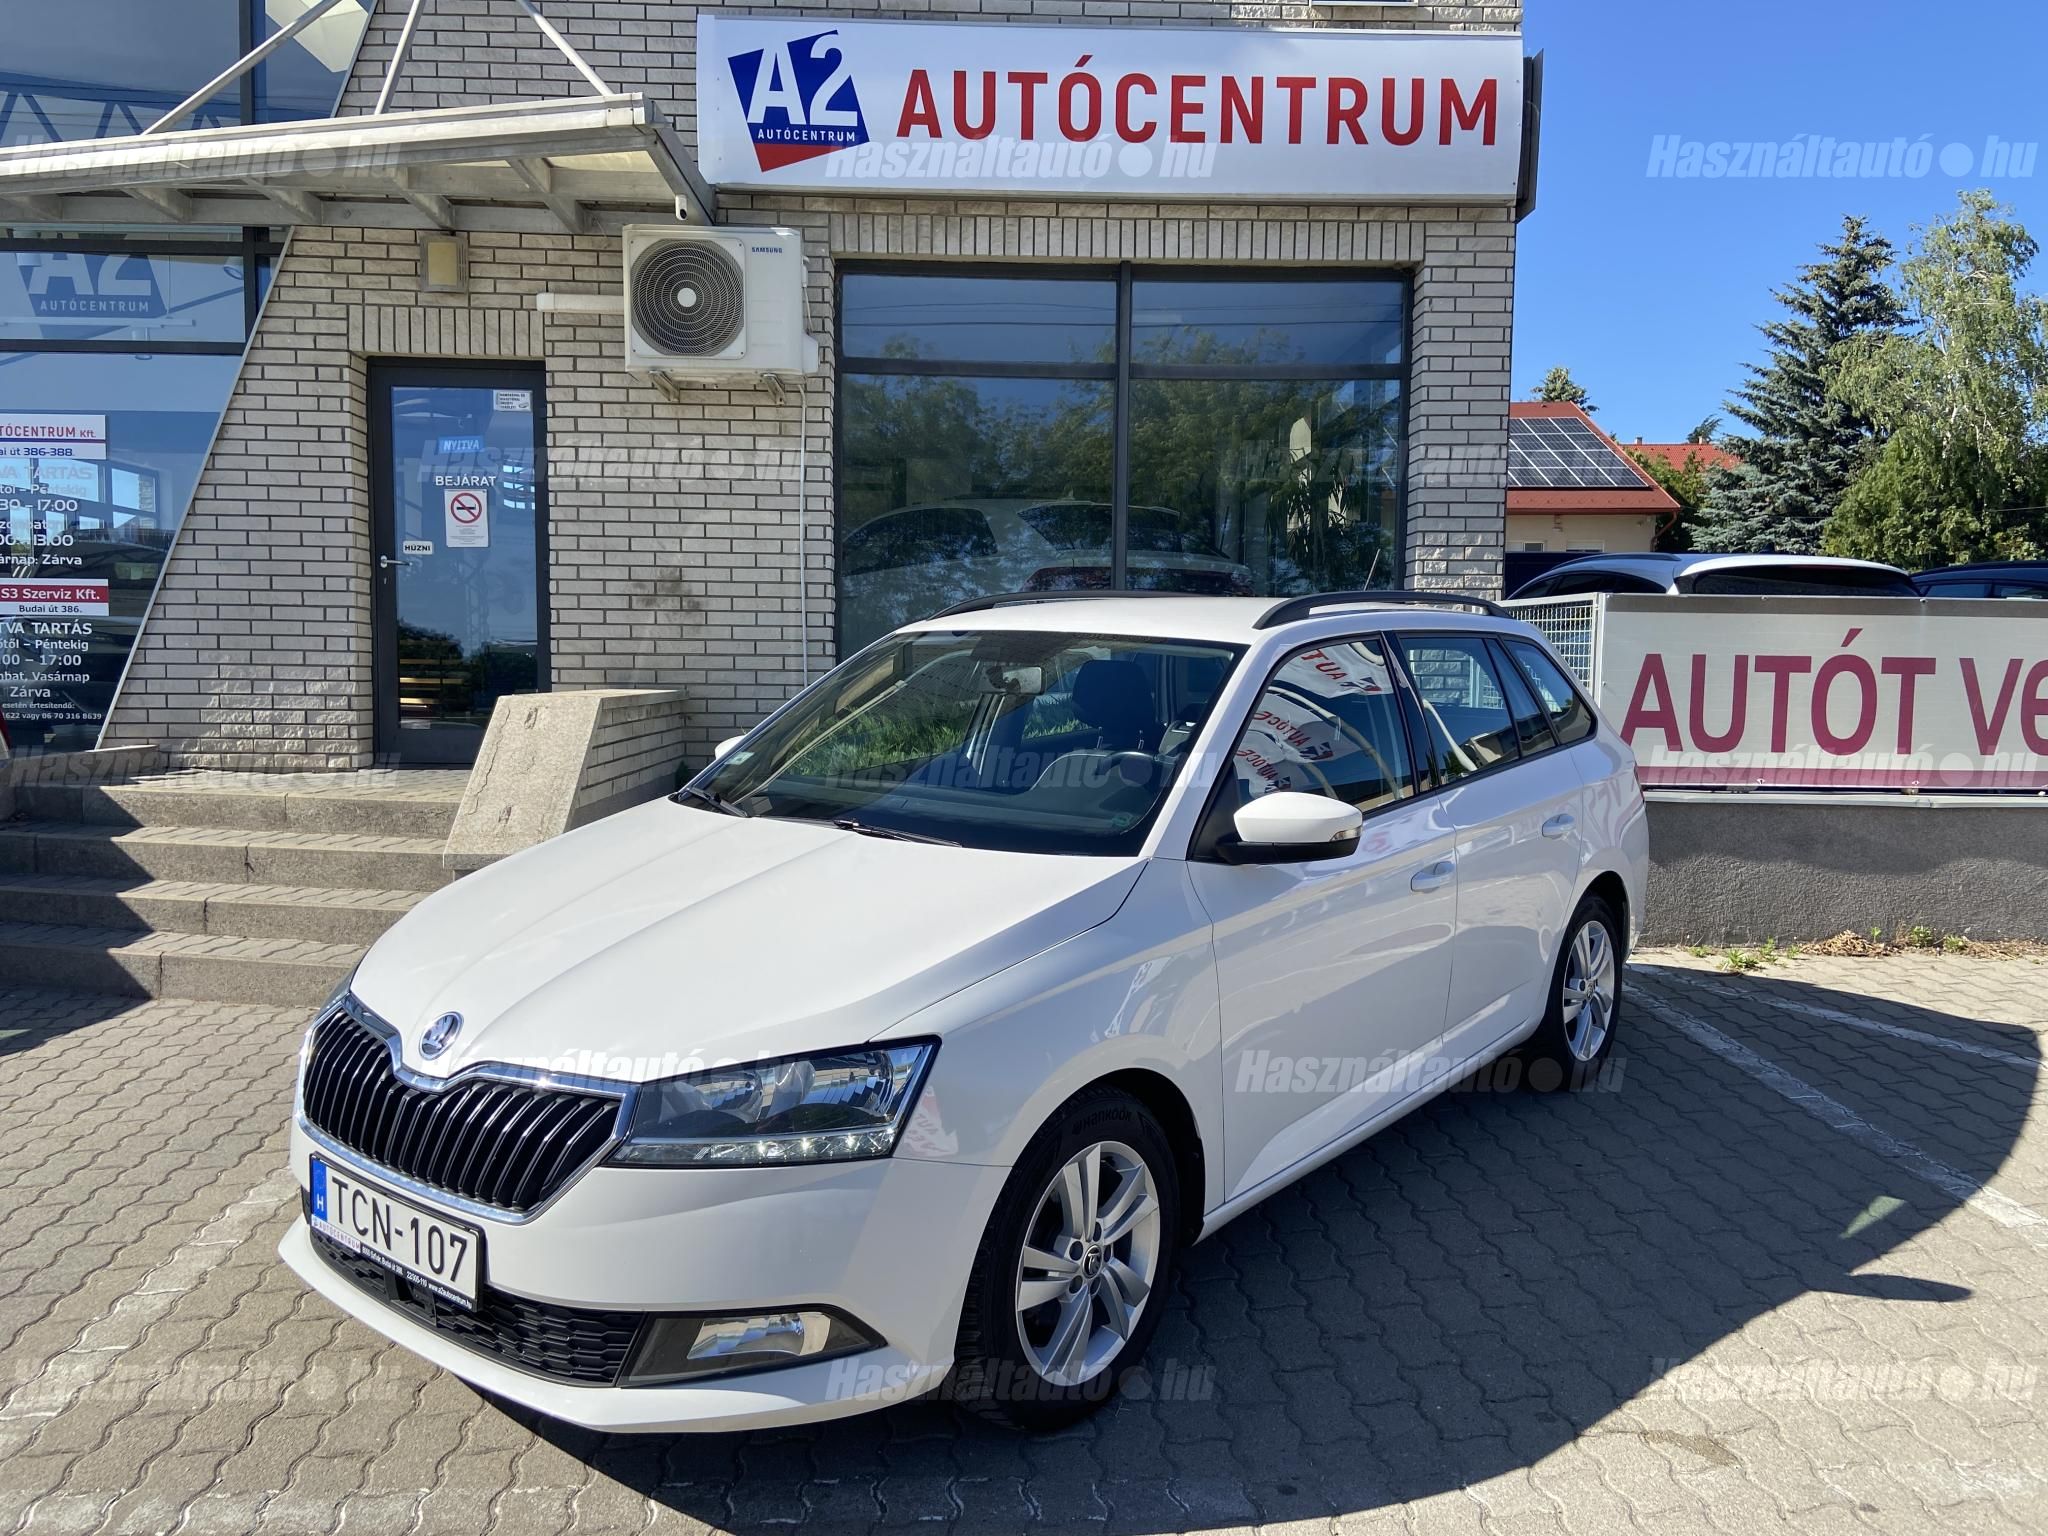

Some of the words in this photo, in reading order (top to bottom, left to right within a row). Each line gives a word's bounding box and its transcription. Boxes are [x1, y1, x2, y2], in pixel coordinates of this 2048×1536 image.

[747, 34, 858, 126] A2
[897, 54, 1498, 147] AUTÓCENTRUM
[758, 127, 856, 142] AUTÓCENTRUM
[751, 246, 783, 254] SAMSUNG
[40, 297, 149, 313] AUTÓCENTRUM
[80, 429, 97, 438] Kft.
[443, 439, 481, 452] NYITVA
[435, 473, 497, 486] BEJÁRAT
[37, 499, 78, 512] 17:00
[42, 553, 82, 566] Zárva
[22, 588, 72, 600] Szerviz
[76, 588, 100, 600] Kft.
[19, 604, 46, 613] Budai
[48, 604, 58, 613] út
[61, 605, 82, 613] 386.
[31, 618, 93, 635] TARTÁS
[35, 638, 89, 652] Péntekig
[40, 654, 82, 666] 17:00
[32, 670, 90, 684] Vasárnap
[10, 685, 51, 698] Zárva
[1621, 628, 1937, 757] AUTÓT
[22, 713, 40, 721] vagy
[315, 1197, 325, 1212] H
[332, 1175, 468, 1284] TCN-107
